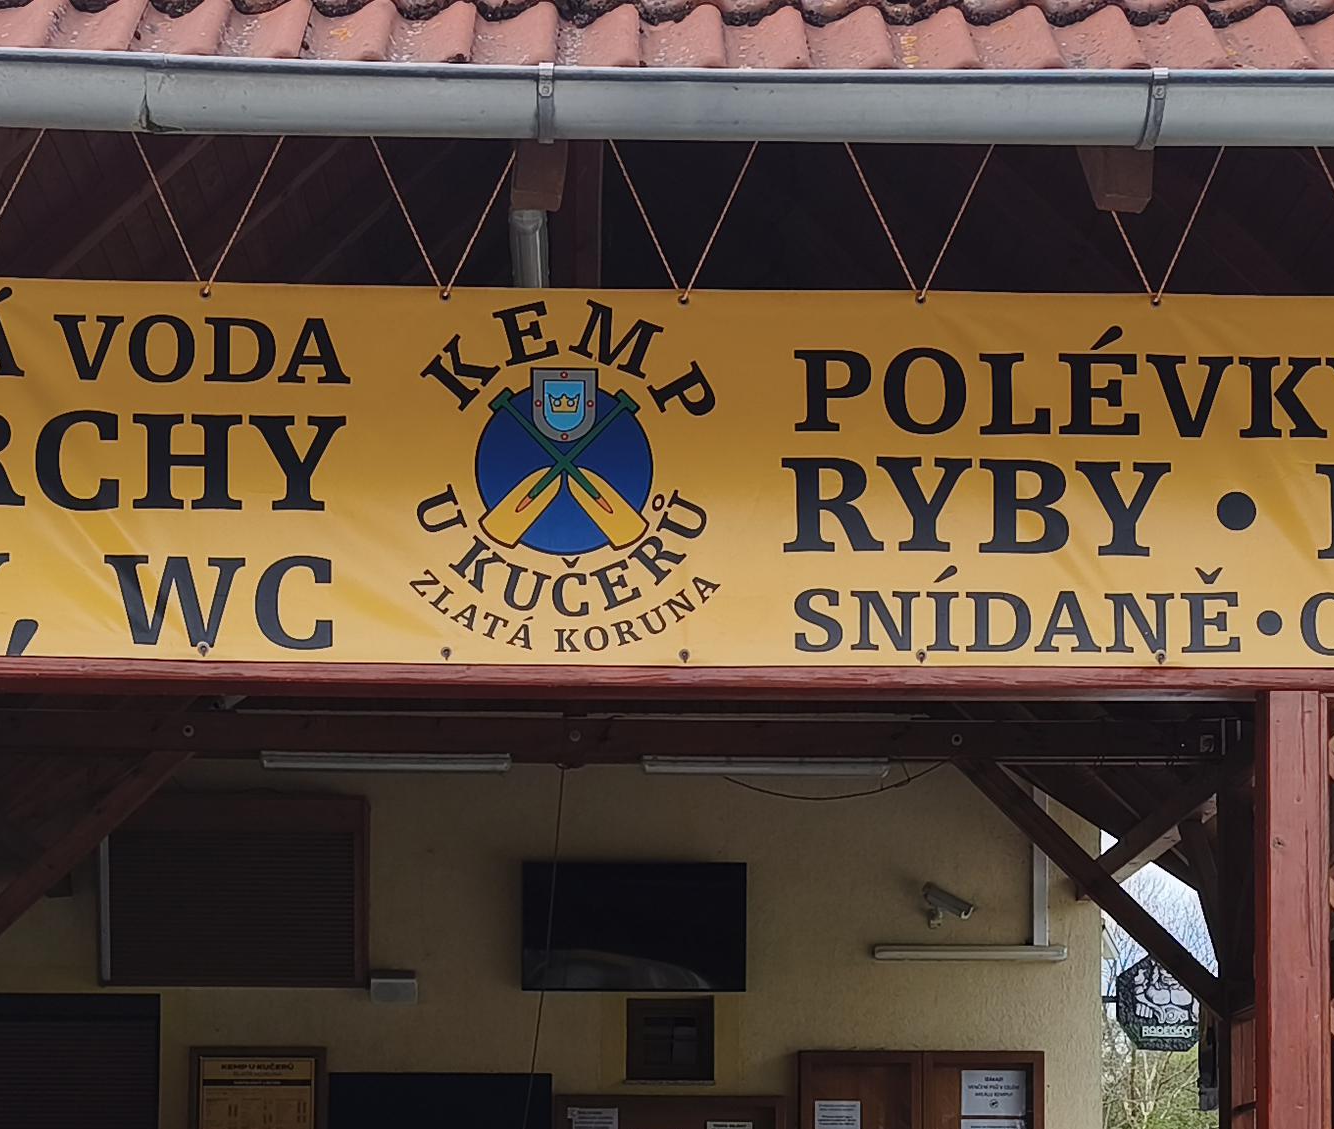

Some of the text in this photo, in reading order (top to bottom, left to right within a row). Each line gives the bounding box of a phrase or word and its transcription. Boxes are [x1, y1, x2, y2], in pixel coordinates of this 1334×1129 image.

[54, 315, 350, 384] VODA
[420, 299, 716, 416] KEMP
[416, 484, 707, 617] U KUČERŮ
[781, 457, 1171, 557] RYBY
[104, 555, 333, 650] WC
[409, 569, 721, 653] ZLATÁ KORUNA
[1142, 1025, 1194, 1038] RADEGAST
